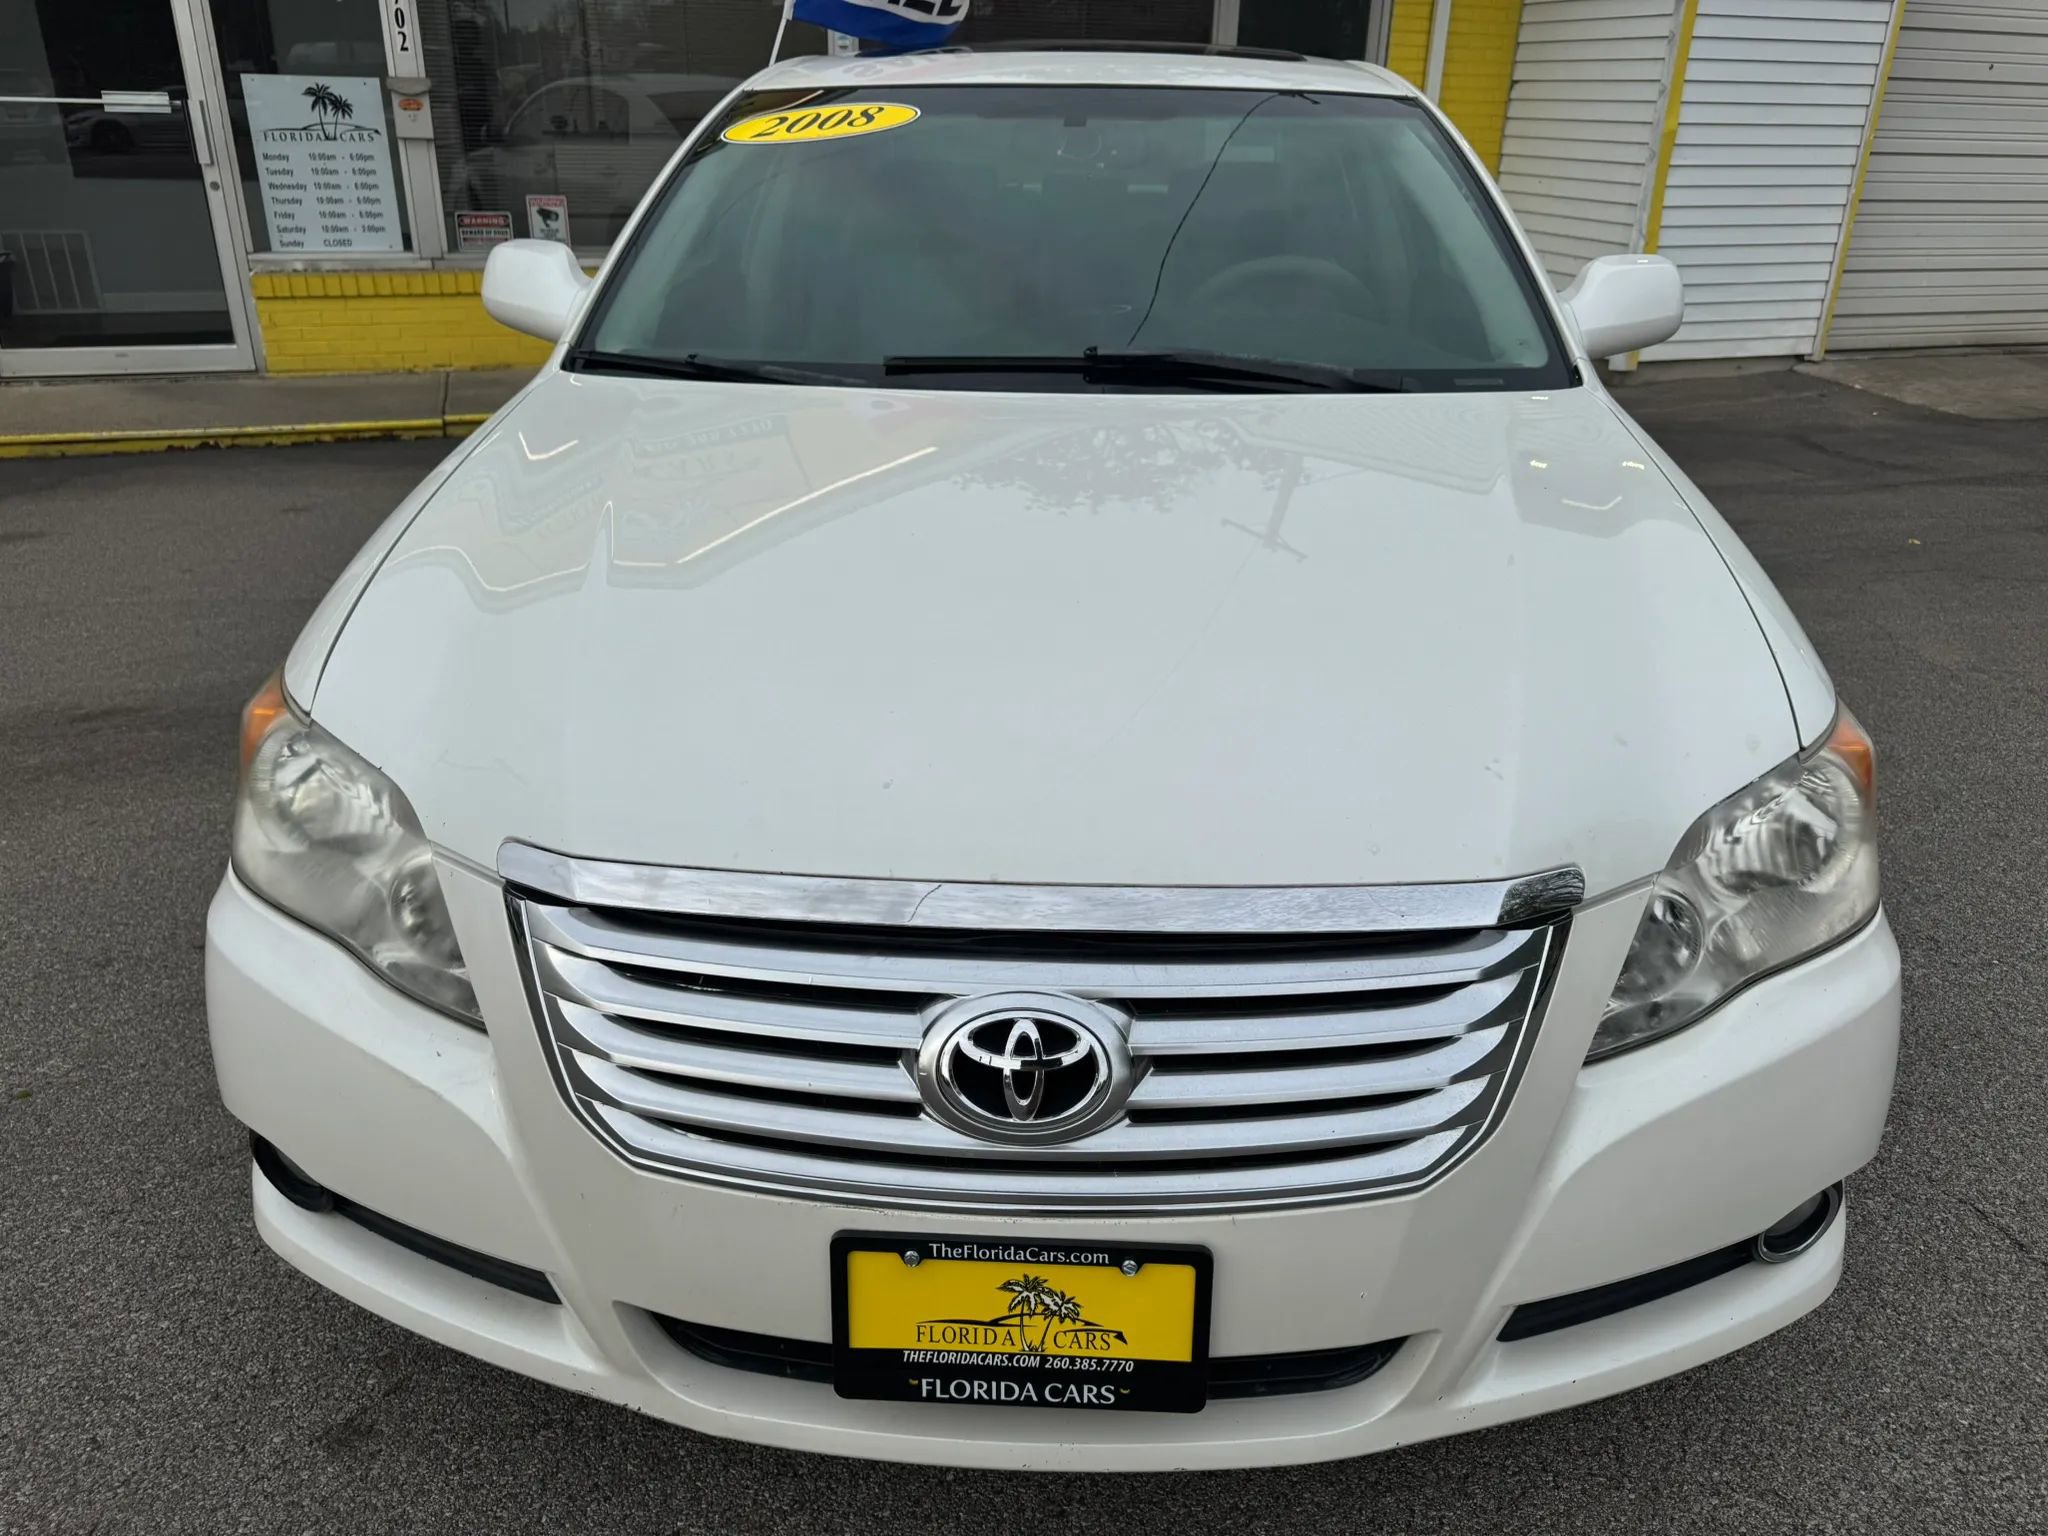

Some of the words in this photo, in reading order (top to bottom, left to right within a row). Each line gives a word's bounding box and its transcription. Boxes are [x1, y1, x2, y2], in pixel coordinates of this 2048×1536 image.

[394, 0, 409, 52] 02
[750, 106, 885, 139] 2008
[263, 132, 322, 142] FLORIDA
[340, 132, 375, 142] CARS
[263, 152, 289, 162] Monday
[265, 167, 294, 176] Tuesday
[268, 182, 307, 192] Wednesday
[271, 197, 302, 206] Thursday
[274, 211, 295, 221] Friday
[463, 216, 505, 225] WARNING
[276, 225, 306, 235] Saturday
[279, 239, 305, 249] Sunday
[323, 239, 352, 248] CLOSED
[928, 1242, 1110, 1265] TheFloridaCars.com
[916, 1325, 1016, 1347] FLORIDA
[1053, 1331, 1111, 1351] CARS
[903, 1350, 1041, 1369] THEFLORIDACARS.COM
[1044, 1356, 1134, 1373] 260.385.7770
[921, 1378, 1038, 1402] FLORIDA
[1044, 1383, 1116, 1405] CARS
